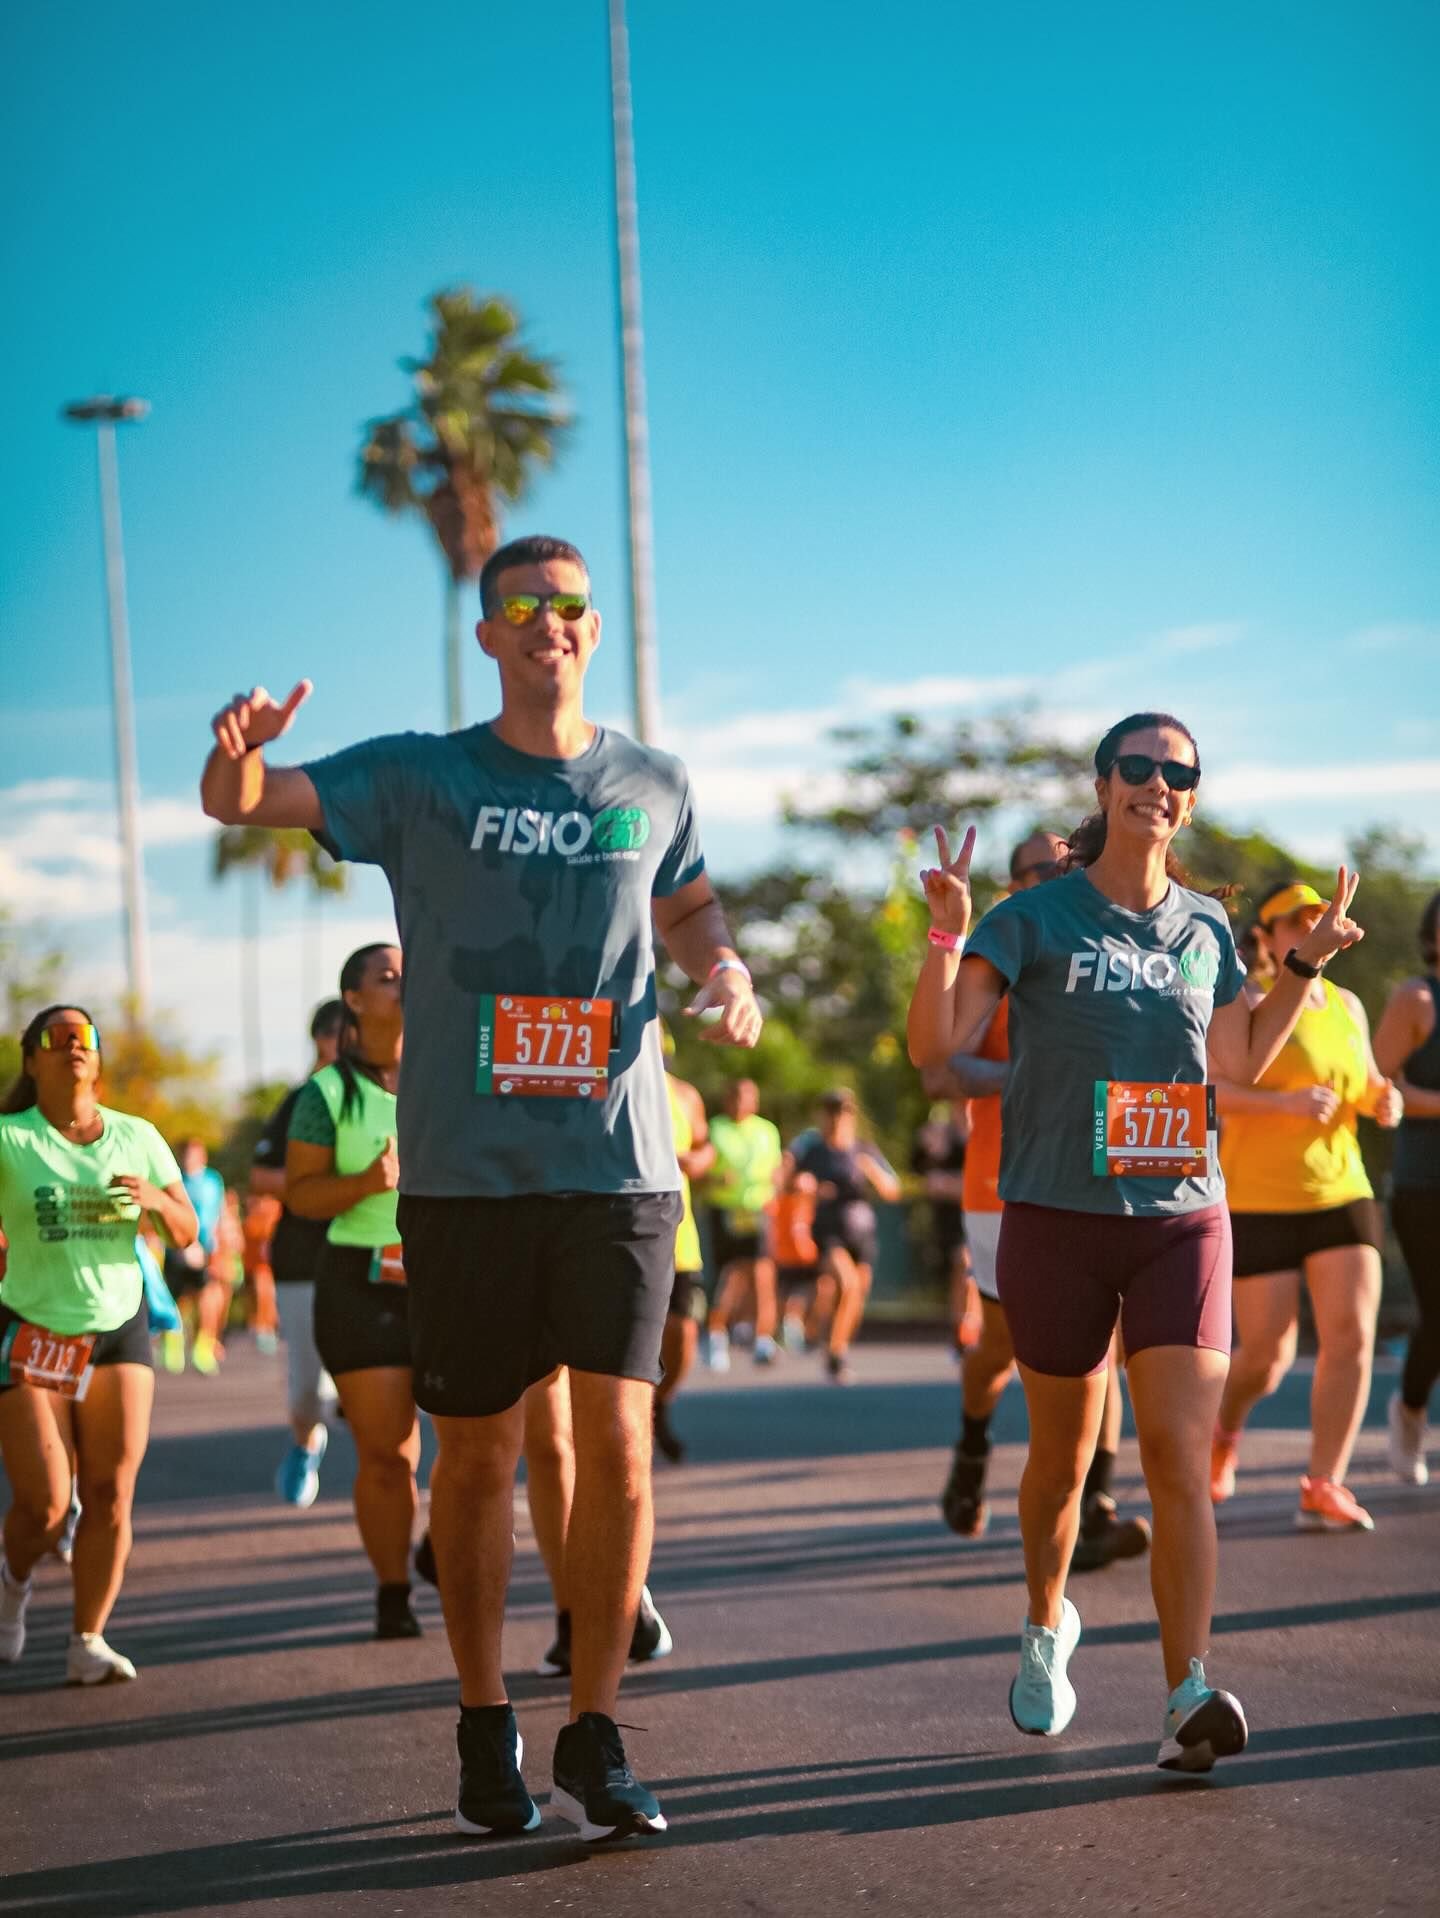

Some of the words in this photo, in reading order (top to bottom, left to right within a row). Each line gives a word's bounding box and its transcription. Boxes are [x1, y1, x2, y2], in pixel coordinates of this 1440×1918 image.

[470, 806, 592, 855] FISIO
[1065, 952, 1176, 992] FISIO
[479, 1025, 490, 1067] VERDE
[516, 1022, 592, 1065] 5773
[1145, 1090, 1168, 1104] SOL
[1095, 1110, 1104, 1150] VERDE
[1125, 1107, 1190, 1146] 5772
